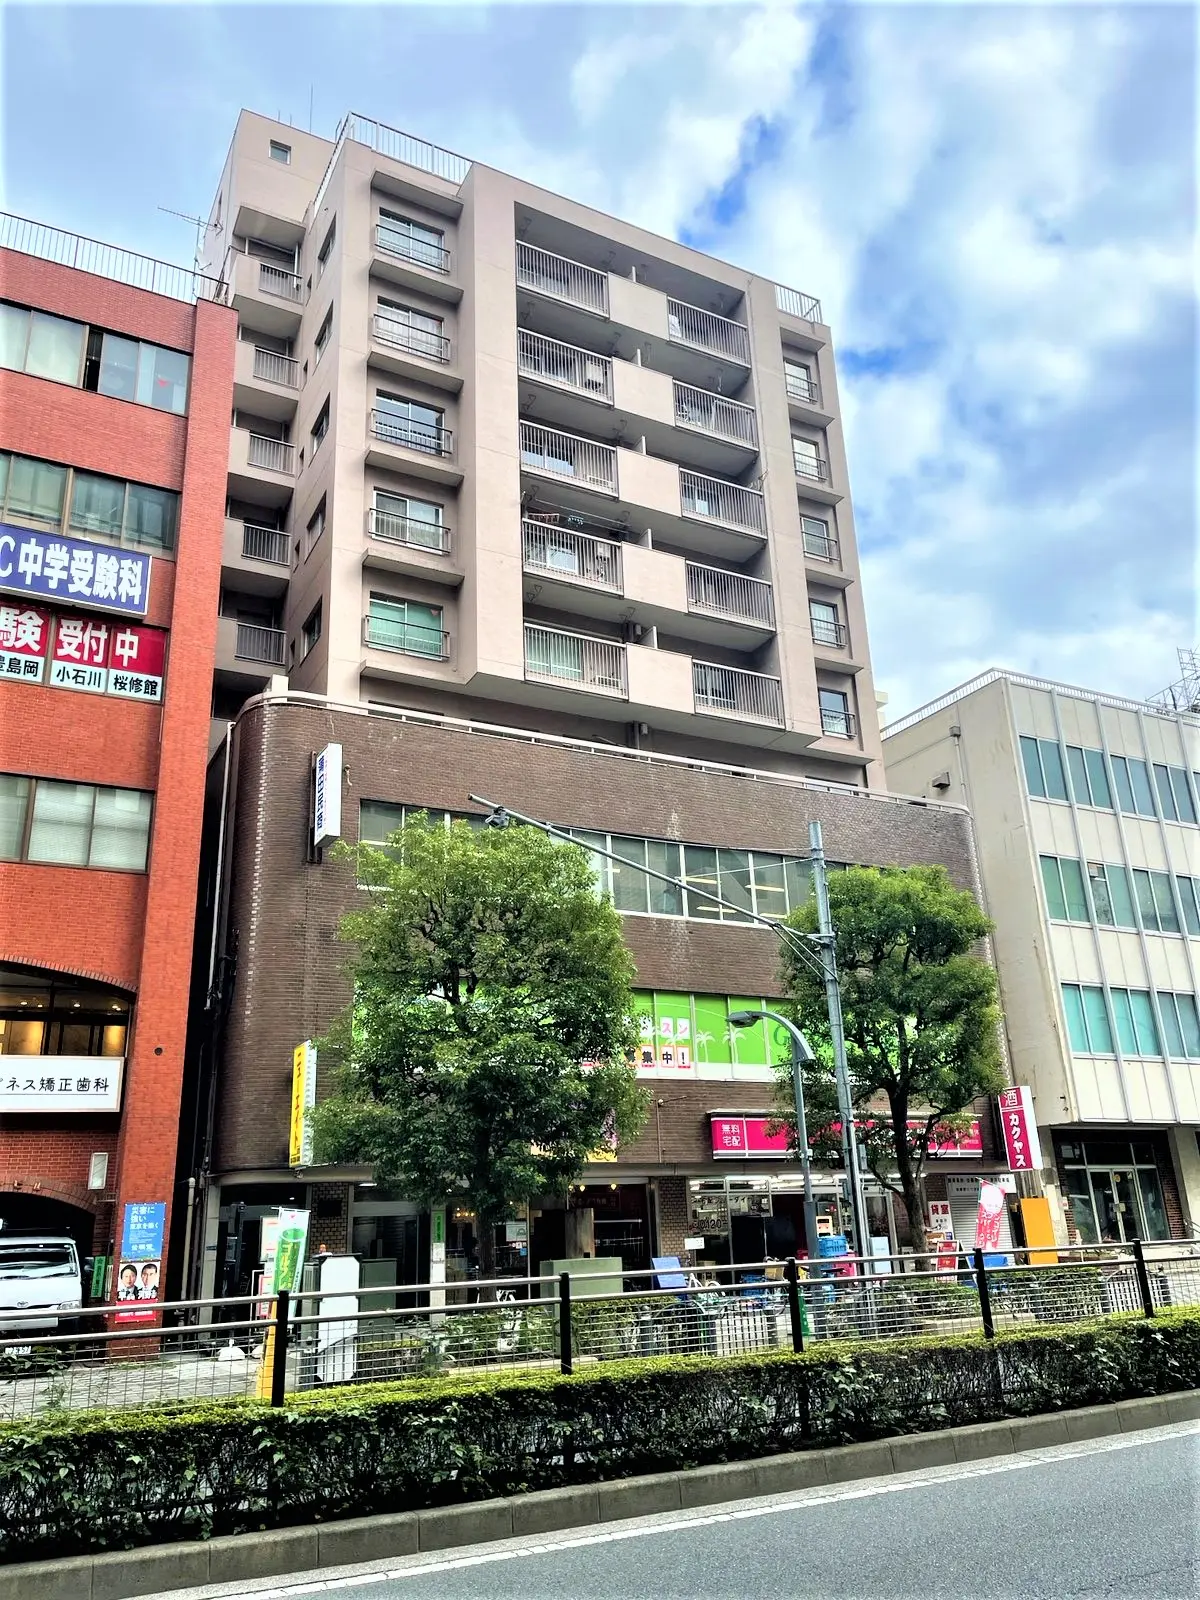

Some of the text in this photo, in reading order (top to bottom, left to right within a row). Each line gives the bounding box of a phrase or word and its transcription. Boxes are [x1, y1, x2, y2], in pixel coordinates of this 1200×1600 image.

[0, 656, 158, 696] 島岡 小石川 桜修館
[0, 1076, 110, 1092] ネス矯正歯科
[1004, 1090, 1018, 1106] 酒
[721, 1123, 740, 1134] 無料
[722, 1135, 742, 1147] 宅配
[1009, 1112, 1027, 1168] カクヤス
